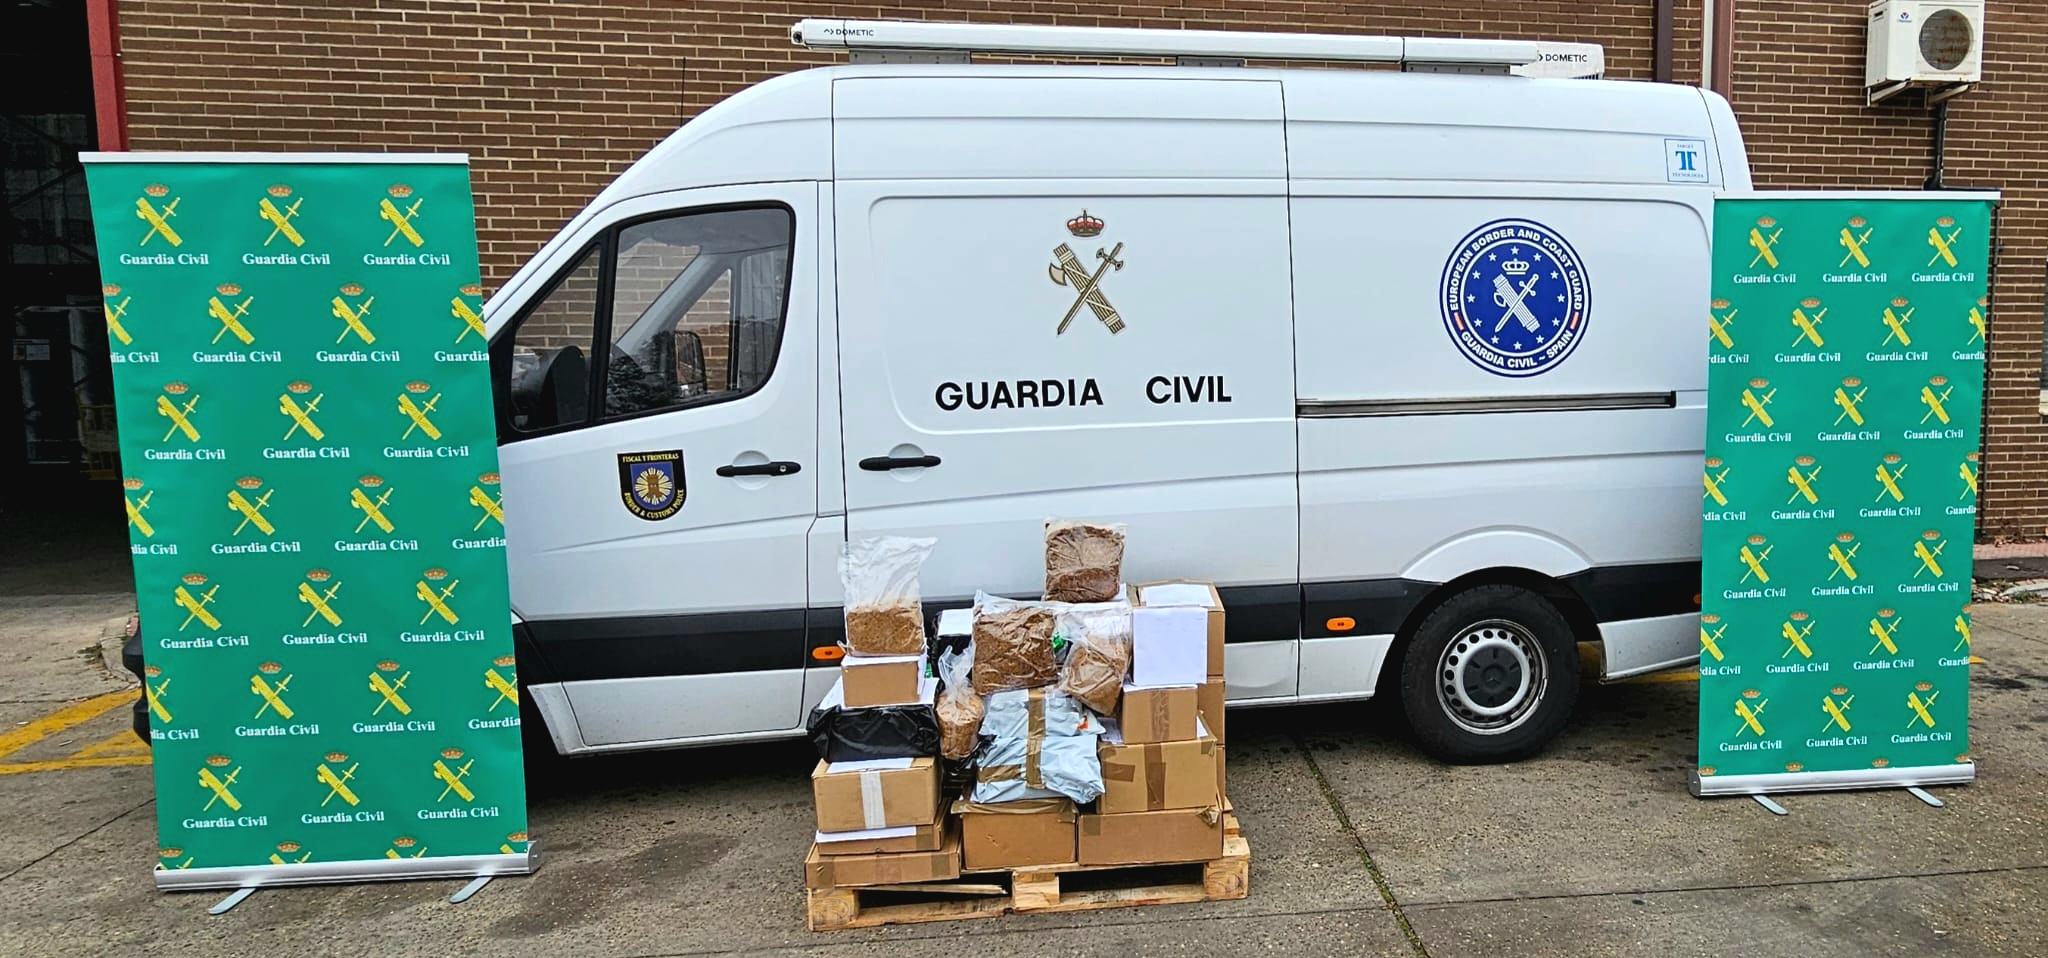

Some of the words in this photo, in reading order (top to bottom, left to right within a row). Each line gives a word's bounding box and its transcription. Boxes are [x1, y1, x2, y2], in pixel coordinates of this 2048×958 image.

[836, 28, 874, 36] DOMETIC
[1545, 54, 1588, 62] DOMETIC
[119, 253, 175, 265] Guardia
[177, 253, 209, 265] Civil
[242, 253, 298, 265] Guardia
[300, 253, 331, 265] Civil
[363, 253, 416, 265] Guardia
[418, 253, 450, 265] Civil
[1449, 250, 1473, 311] EUROPEAN
[1472, 228, 1515, 251] BORDER
[1517, 229, 1541, 241] AND
[1542, 238, 1573, 268] COAST
[1569, 270, 1582, 310] GUARD
[1733, 274, 1771, 284] Guardia
[1773, 273, 1796, 283] Civil
[1822, 273, 1863, 283] Guardia
[1864, 273, 1887, 283] Civil
[1911, 272, 1950, 282] Guardia
[1951, 272, 1975, 282] Civil
[1461, 331, 1505, 366] GUARDIA
[1507, 357, 1538, 368] CIVIL
[1547, 330, 1573, 358] SPAIN
[127, 351, 159, 363] Civil
[192, 351, 247, 363] Guardia
[249, 351, 282, 362] Civil
[316, 350, 368, 362] Guardia
[370, 350, 400, 362] Civil
[1728, 354, 1749, 363] Civil
[1774, 352, 1816, 363] Guardia
[1818, 352, 1841, 362] Civil
[1865, 351, 1904, 362] Guardia
[1905, 351, 1928, 361] Civil
[935, 379, 1104, 411] GUARDIA
[1146, 375, 1232, 404] CIVIL
[1725, 432, 1766, 443] Guardia
[1768, 432, 1792, 442] Civil
[1817, 431, 1857, 441] Guardia
[1858, 431, 1880, 441] Civil
[1903, 430, 1943, 439] Guardia
[1944, 429, 1964, 439] Civil
[144, 449, 193, 460] Guardia
[195, 448, 226, 460] Civil
[262, 447, 317, 459] Guardia
[319, 447, 350, 458] Civil
[383, 447, 433, 458] Guardia
[436, 445, 469, 457] Civil
[647, 453, 679, 461] FRONTERAS
[647, 507, 675, 518] CUSTOMS
[1722, 511, 1746, 521] Civil
[1771, 510, 1811, 520] Guardia
[1812, 509, 1835, 519] Civil
[1859, 508, 1897, 517] Guardia
[1898, 506, 1921, 516] Civil
[149, 544, 178, 555] Civil
[211, 542, 268, 554] Guardia
[270, 541, 301, 553] Civil
[334, 540, 387, 552] Guardia
[389, 539, 418, 551] Civil
[1811, 586, 1850, 596] Guardia
[1851, 585, 1874, 595] Civil
[1897, 583, 1936, 593] Guardia
[1937, 582, 1959, 592] Civil
[1723, 589, 1762, 599] Guardia
[1763, 588, 1786, 597] Civil
[160, 637, 214, 649] Guardia
[216, 635, 249, 647] Civil
[282, 633, 335, 645] Guardia
[337, 632, 368, 644] Civil
[400, 631, 451, 643] Guardia
[454, 630, 485, 642] Civil
[1719, 665, 1741, 675] Civil
[1765, 663, 1805, 673] Guardia
[1807, 662, 1829, 672] Civil
[1853, 660, 1891, 670] Guardia
[1892, 659, 1914, 668] Civil
[235, 725, 287, 737] Guardia
[289, 724, 319, 735] Civil
[352, 721, 405, 733] Guardia
[407, 721, 436, 731] Civil
[167, 728, 199, 740] Civil
[1891, 733, 1928, 743] Guardia
[1929, 732, 1952, 741] Civil
[1719, 741, 1758, 752] Guardia
[1759, 740, 1782, 750] Civil
[1806, 737, 1844, 747] Guardia
[1845, 736, 1868, 746] Civil
[301, 812, 353, 824] Guardia
[355, 811, 385, 822] Civil
[417, 808, 468, 820] Guardia
[470, 806, 499, 818] Civil
[182, 817, 235, 829] Guardia
[237, 815, 268, 827] Civil
